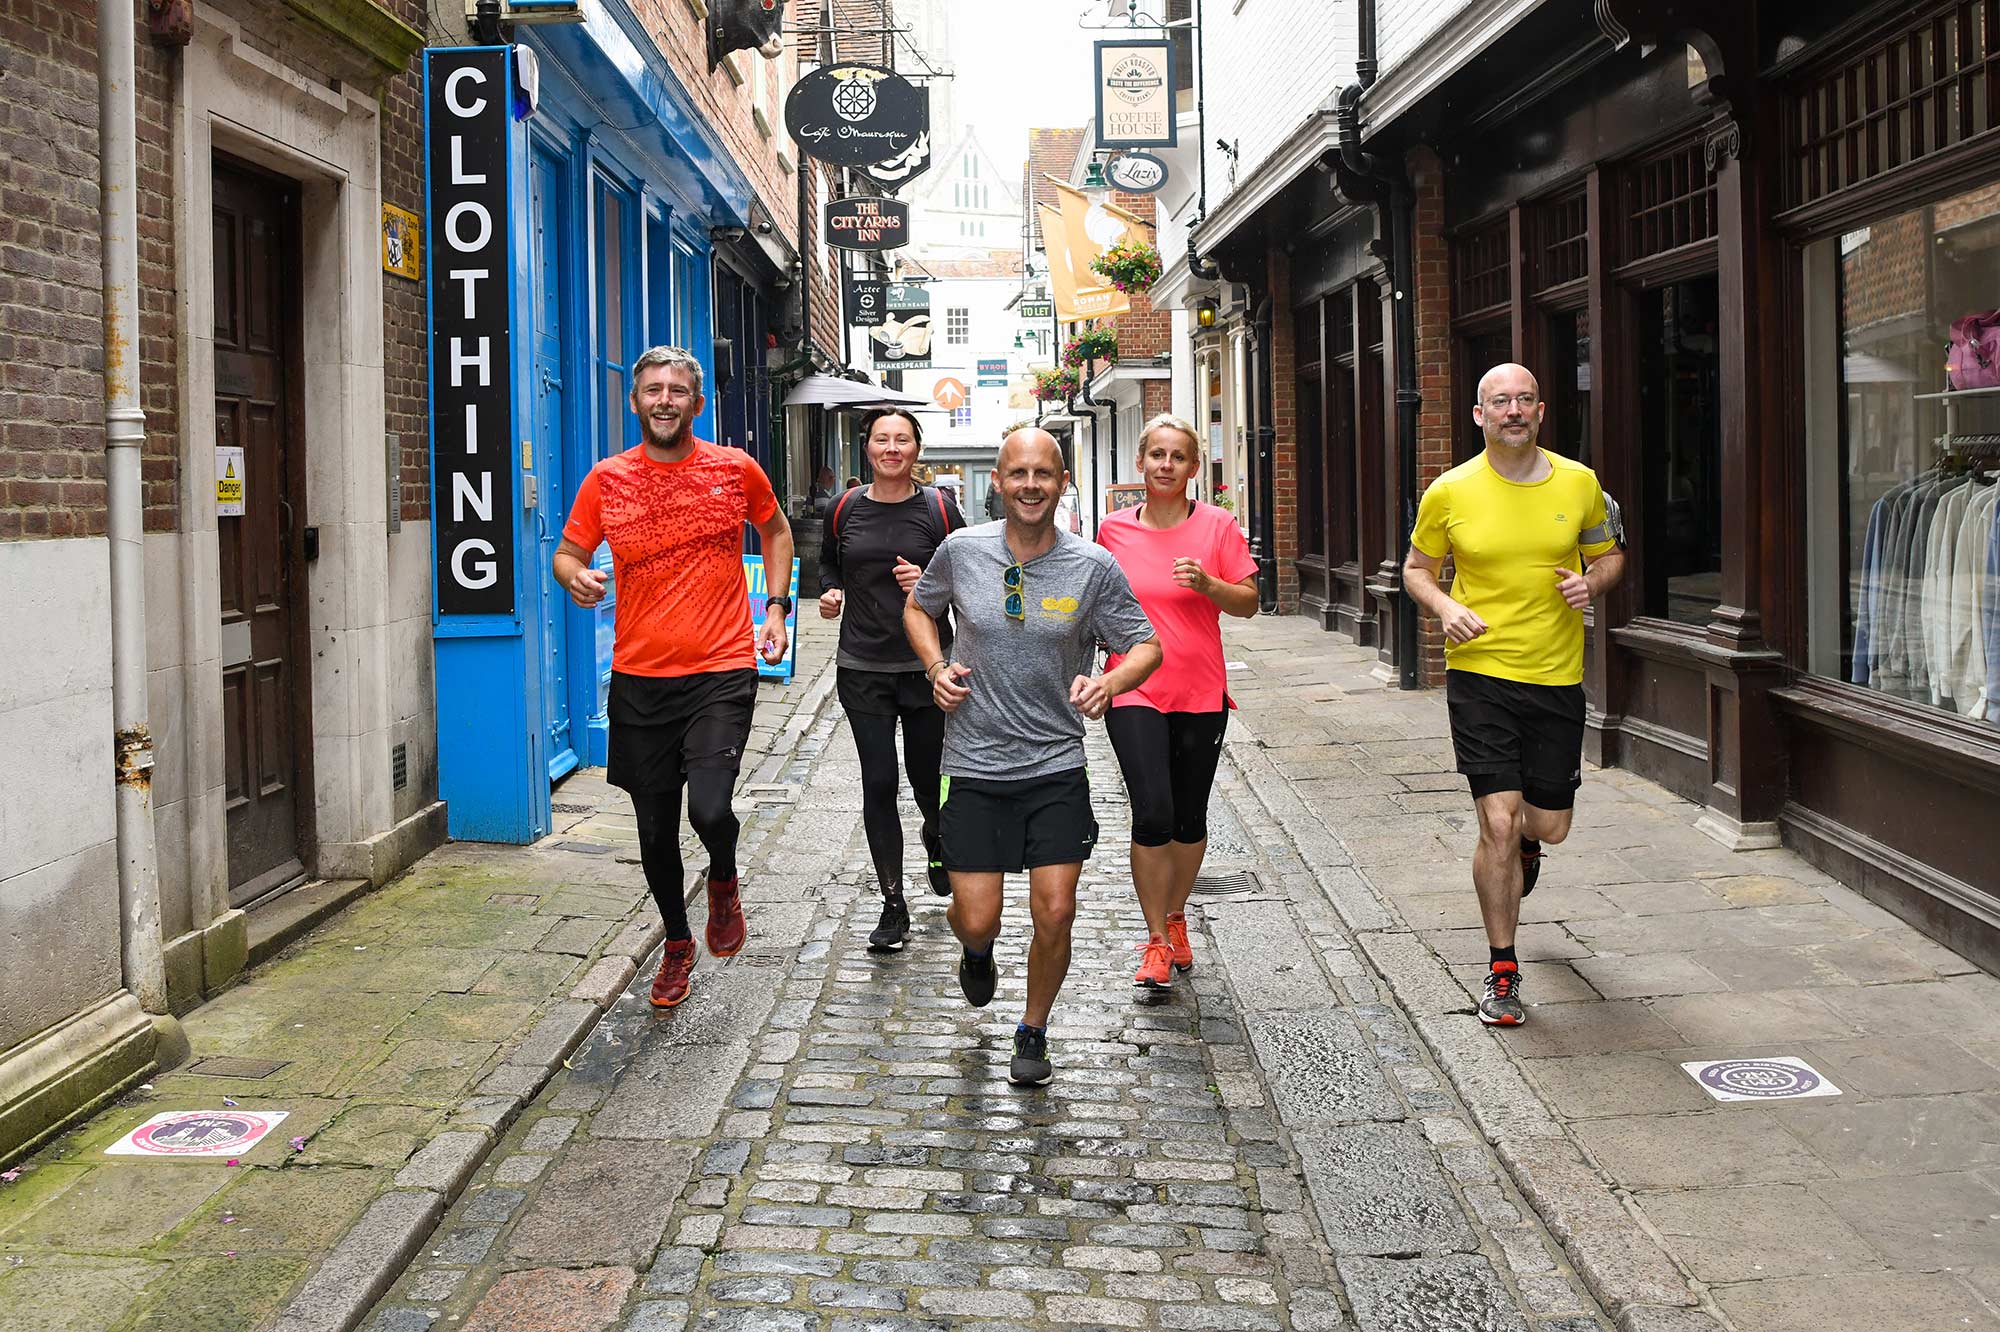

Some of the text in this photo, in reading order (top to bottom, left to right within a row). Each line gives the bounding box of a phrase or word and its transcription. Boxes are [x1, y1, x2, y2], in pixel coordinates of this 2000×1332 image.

[1109, 112, 1162, 123] COFFEE
[1110, 123, 1162, 135] HOUSE
[854, 202, 879, 215] THE
[831, 215, 901, 230] CITY ARMS
[857, 229, 881, 242] INN
[853, 284, 880, 293] Aztec
[1022, 306, 1049, 316] TO LET
[444, 66, 497, 590] CLOTHING
[876, 361, 928, 370] SHAKESPEARE
[218, 480, 241, 496] Danger
